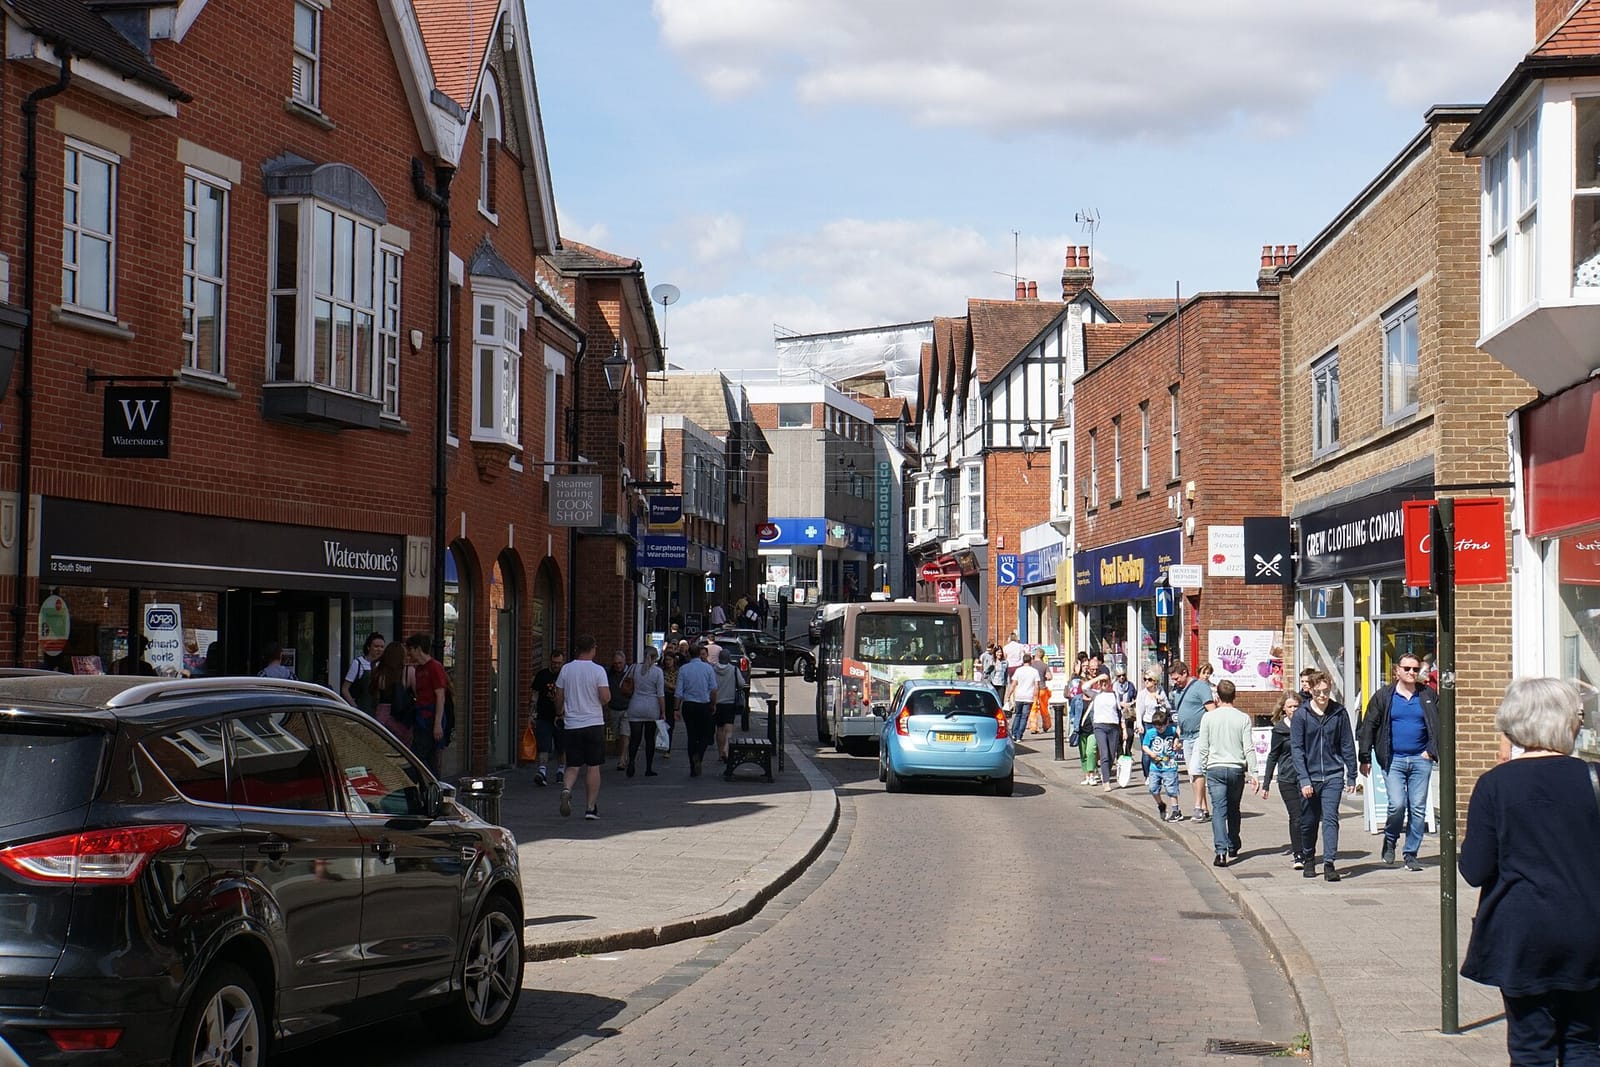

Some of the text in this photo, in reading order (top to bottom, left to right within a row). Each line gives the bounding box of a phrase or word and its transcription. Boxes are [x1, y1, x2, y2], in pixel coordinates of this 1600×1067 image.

[118, 399, 160, 431] W
[112, 435, 164, 446] Waterstone's
[556, 480, 593, 489] steamer
[556, 487, 593, 500] trading
[556, 499, 593, 511] COOK
[879, 462, 889, 552] OUTDOORWEAR
[556, 510, 593, 521] SHOP
[1306, 508, 1404, 557] CREW CLOTHING COMPA
[650, 544, 686, 552] Carphone
[1419, 534, 1491, 553] Ctons
[323, 540, 398, 572] Waterstone's
[50, 562, 92, 573] 12 South Street
[1256, 562, 1280, 570] C C
[1000, 563, 1015, 584] S
